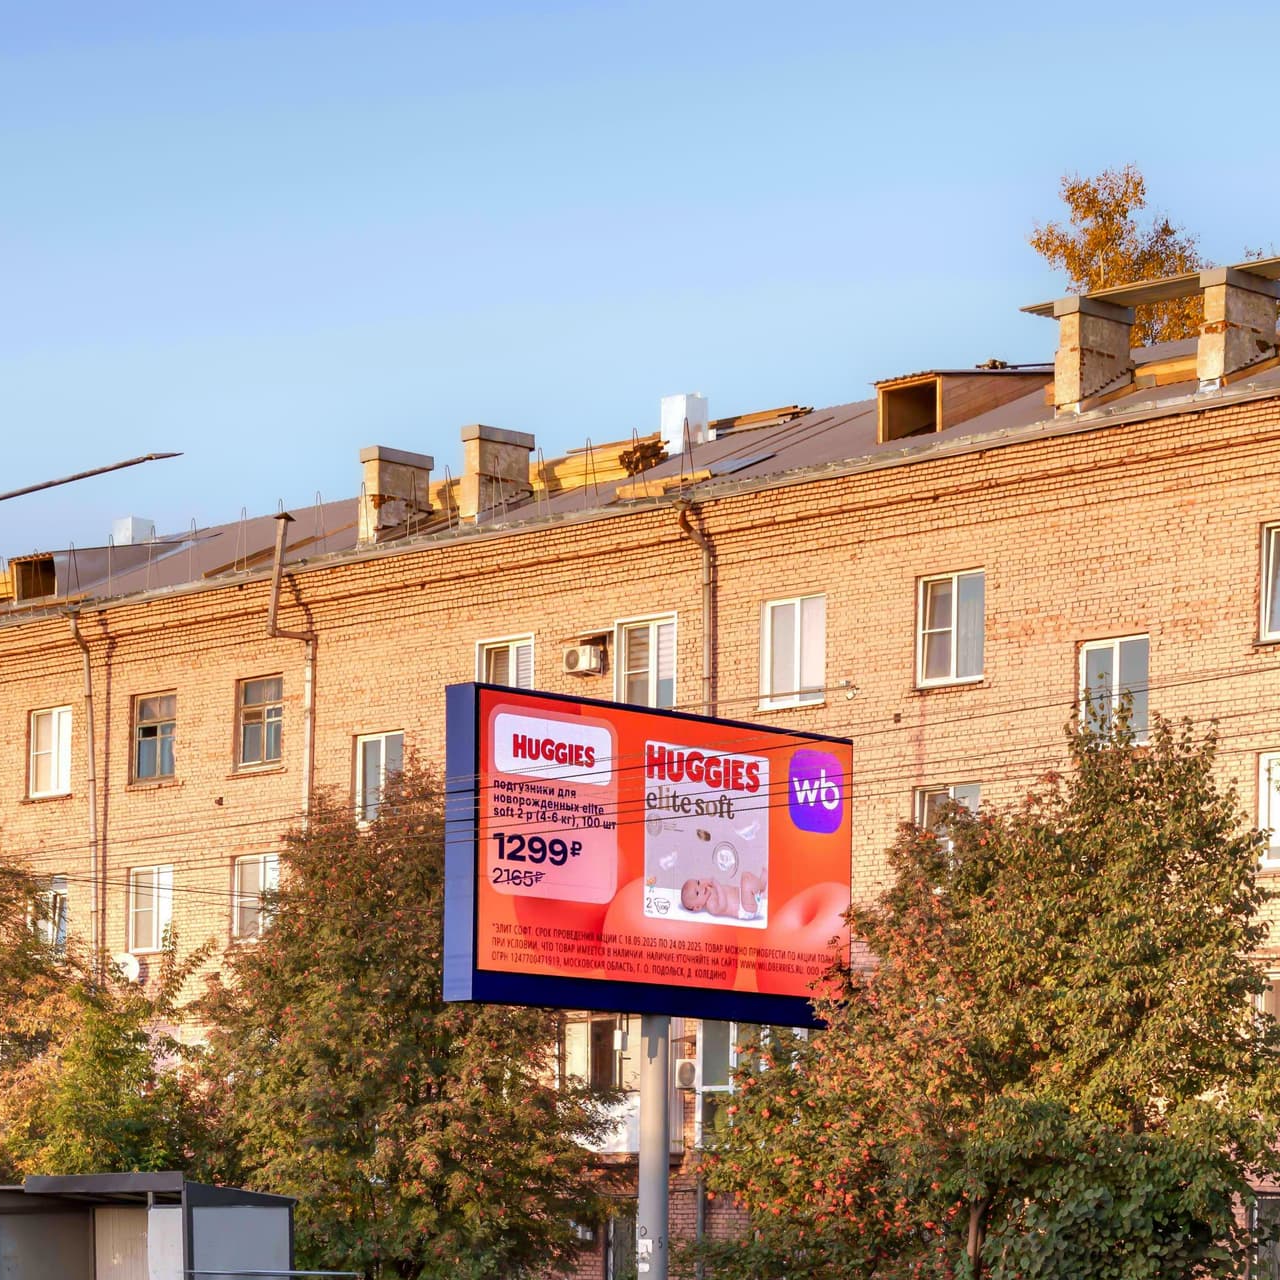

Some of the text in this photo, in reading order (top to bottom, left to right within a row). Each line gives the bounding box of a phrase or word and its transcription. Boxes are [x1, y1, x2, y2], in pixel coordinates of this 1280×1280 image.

[512, 733, 595, 768] HUGGIES
[646, 744, 760, 793] HUGGIES
[493, 780, 577, 800] подгузники для
[493, 794, 604, 816] новорожденных elite
[646, 785, 735, 820] elite soft
[793, 769, 839, 810] wb
[493, 806, 514, 818] soft
[517, 808, 523, 819] 2
[536, 812, 558, 824] (4-6
[582, 816, 600, 829] 100
[602, 820, 617, 830] шт
[492, 936, 505, 947] ПРИ
[541, 942, 553, 952] ЧТО
[556, 942, 575, 953] ТОВАР
[577, 945, 605, 957] ИМЕЕТСЯ
[712, 957, 719, 966] НА
[721, 956, 738, 969] САЙТЕ
[535, 927, 551, 938] СРОК
[659, 938, 668, 949] ПО
[705, 942, 723, 953] ТОВАР
[724, 944, 748, 956] МОЖНО
[748, 947, 786, 960] ПРИОБРЕСТИ
[787, 951, 795, 961] ПО
[563, 957, 605, 969] МОСКОВСКАЯ
